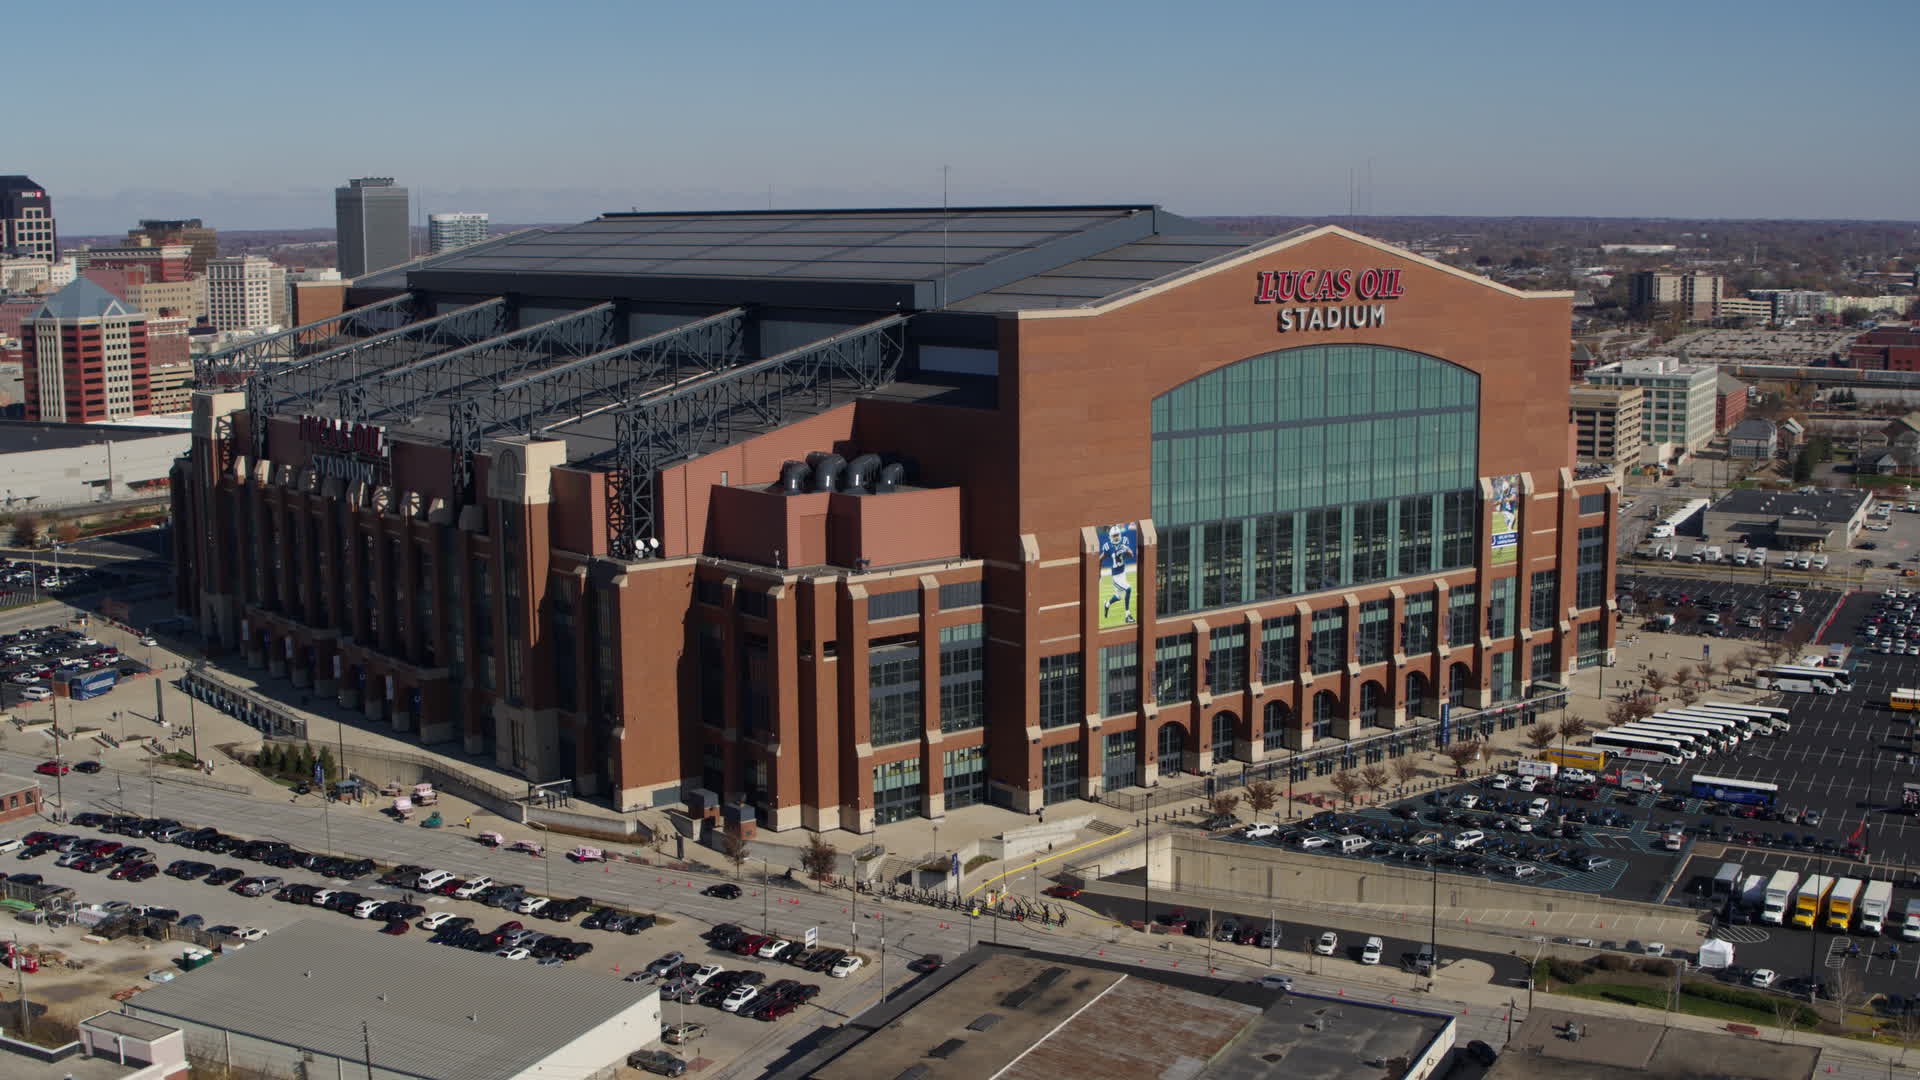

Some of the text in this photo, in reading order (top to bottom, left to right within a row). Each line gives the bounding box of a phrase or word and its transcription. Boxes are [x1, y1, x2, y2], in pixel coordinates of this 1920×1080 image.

[1258, 267, 1405, 301] LUCAS OIL
[1280, 304, 1385, 331] STADIUM
[311, 454, 374, 485] STADIUM
